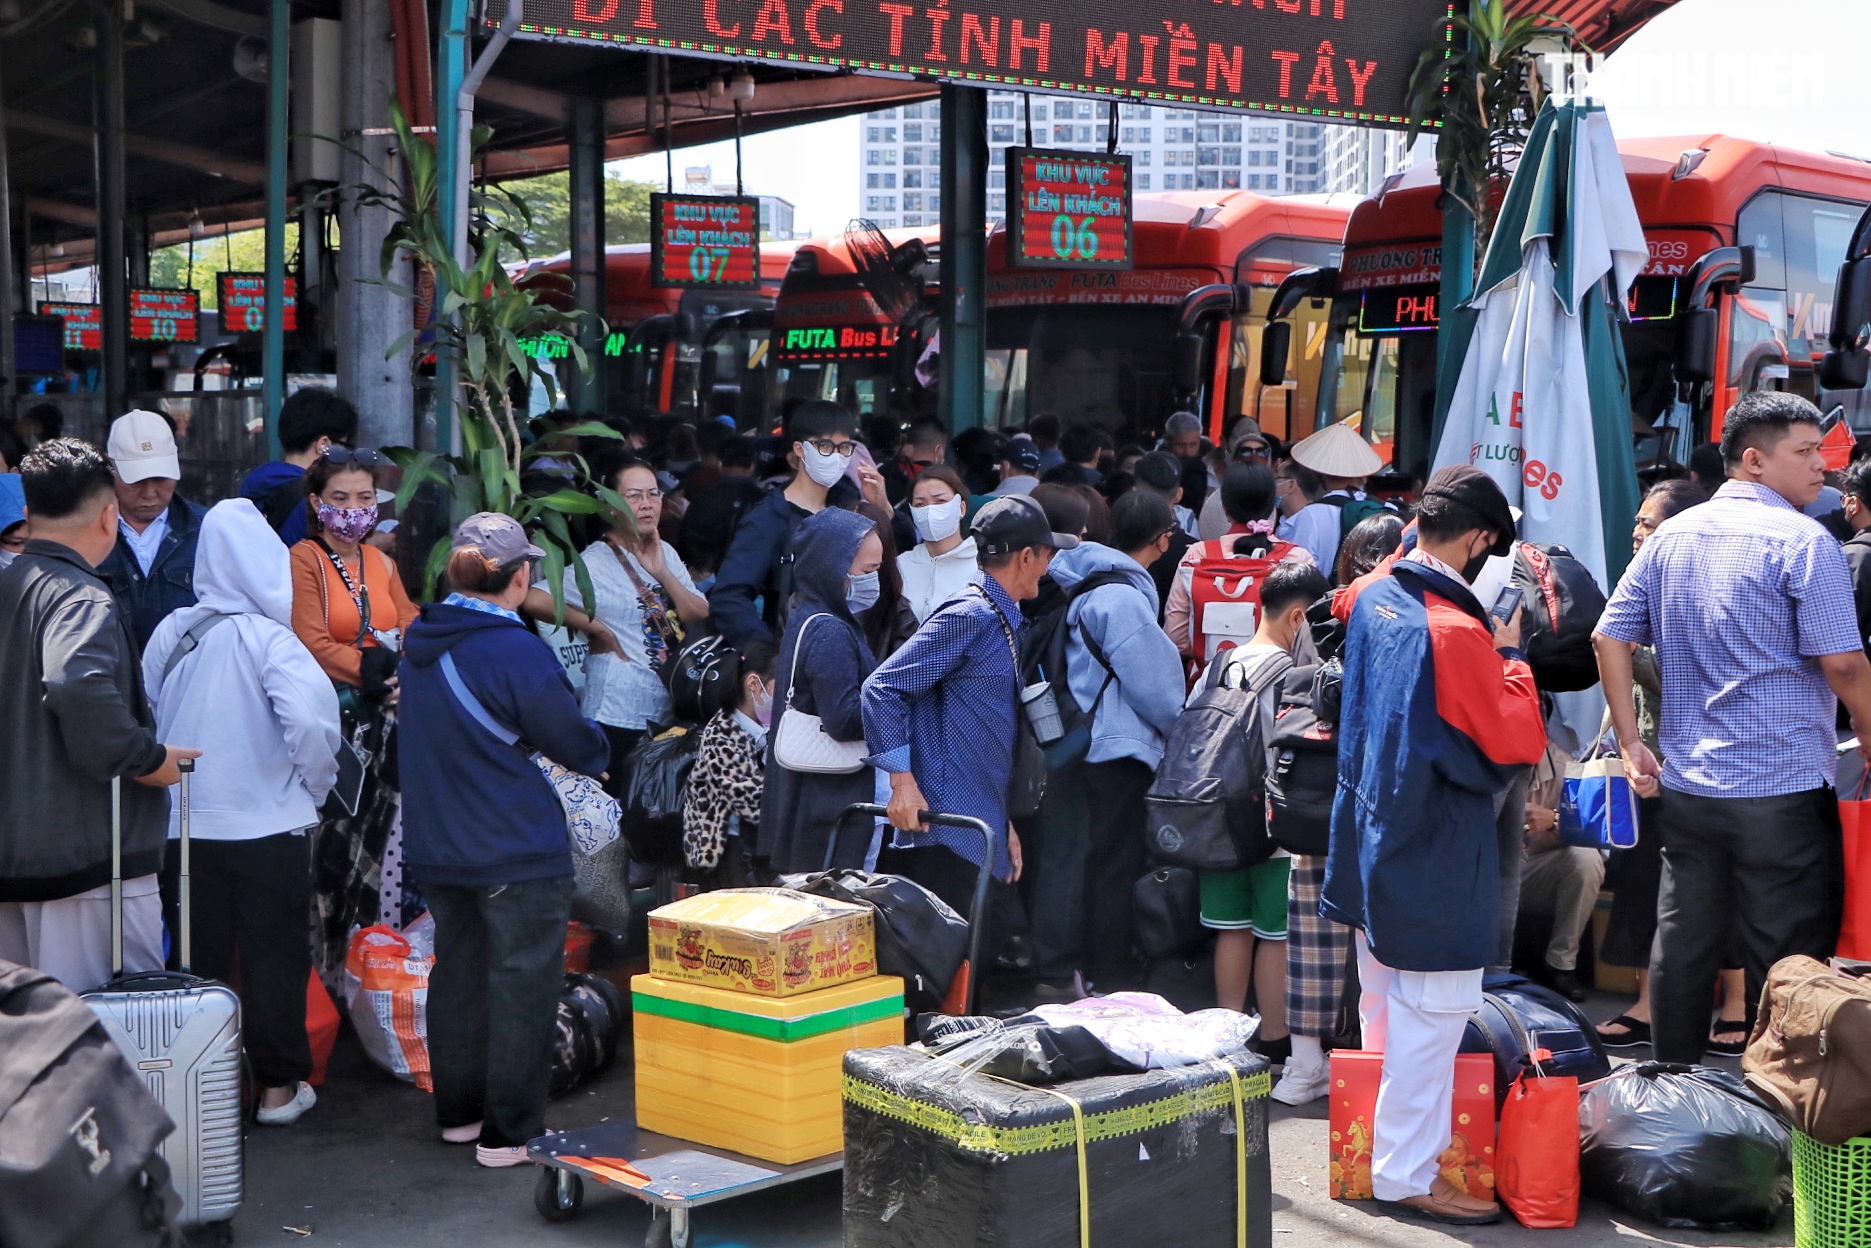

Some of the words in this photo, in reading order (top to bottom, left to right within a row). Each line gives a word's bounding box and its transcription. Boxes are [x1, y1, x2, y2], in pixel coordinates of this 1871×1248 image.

[1084, 20, 1244, 94] MIỀN
[1271, 40, 1378, 107] TÂY
[1036, 162, 1071, 183] KHU
[1074, 164, 1110, 189] VỰC
[1028, 187, 1060, 213] LÊN
[1064, 190, 1121, 216] KHÁCH
[674, 204, 706, 222] KHU
[708, 205, 740, 227] VỰC
[668, 224, 696, 246] LÊN
[699, 227, 751, 248] KHÁCH
[1051, 214, 1099, 258] 06
[689, 246, 731, 281] 07
[1070, 272, 1118, 289] FUTA
[1375, 275, 1397, 286] XE
[1125, 294, 1150, 304] AN
[64, 330, 83, 348] 11
[151, 318, 178, 340] 10
[786, 328, 836, 349] FUTA
[840, 327, 877, 347] Bus
